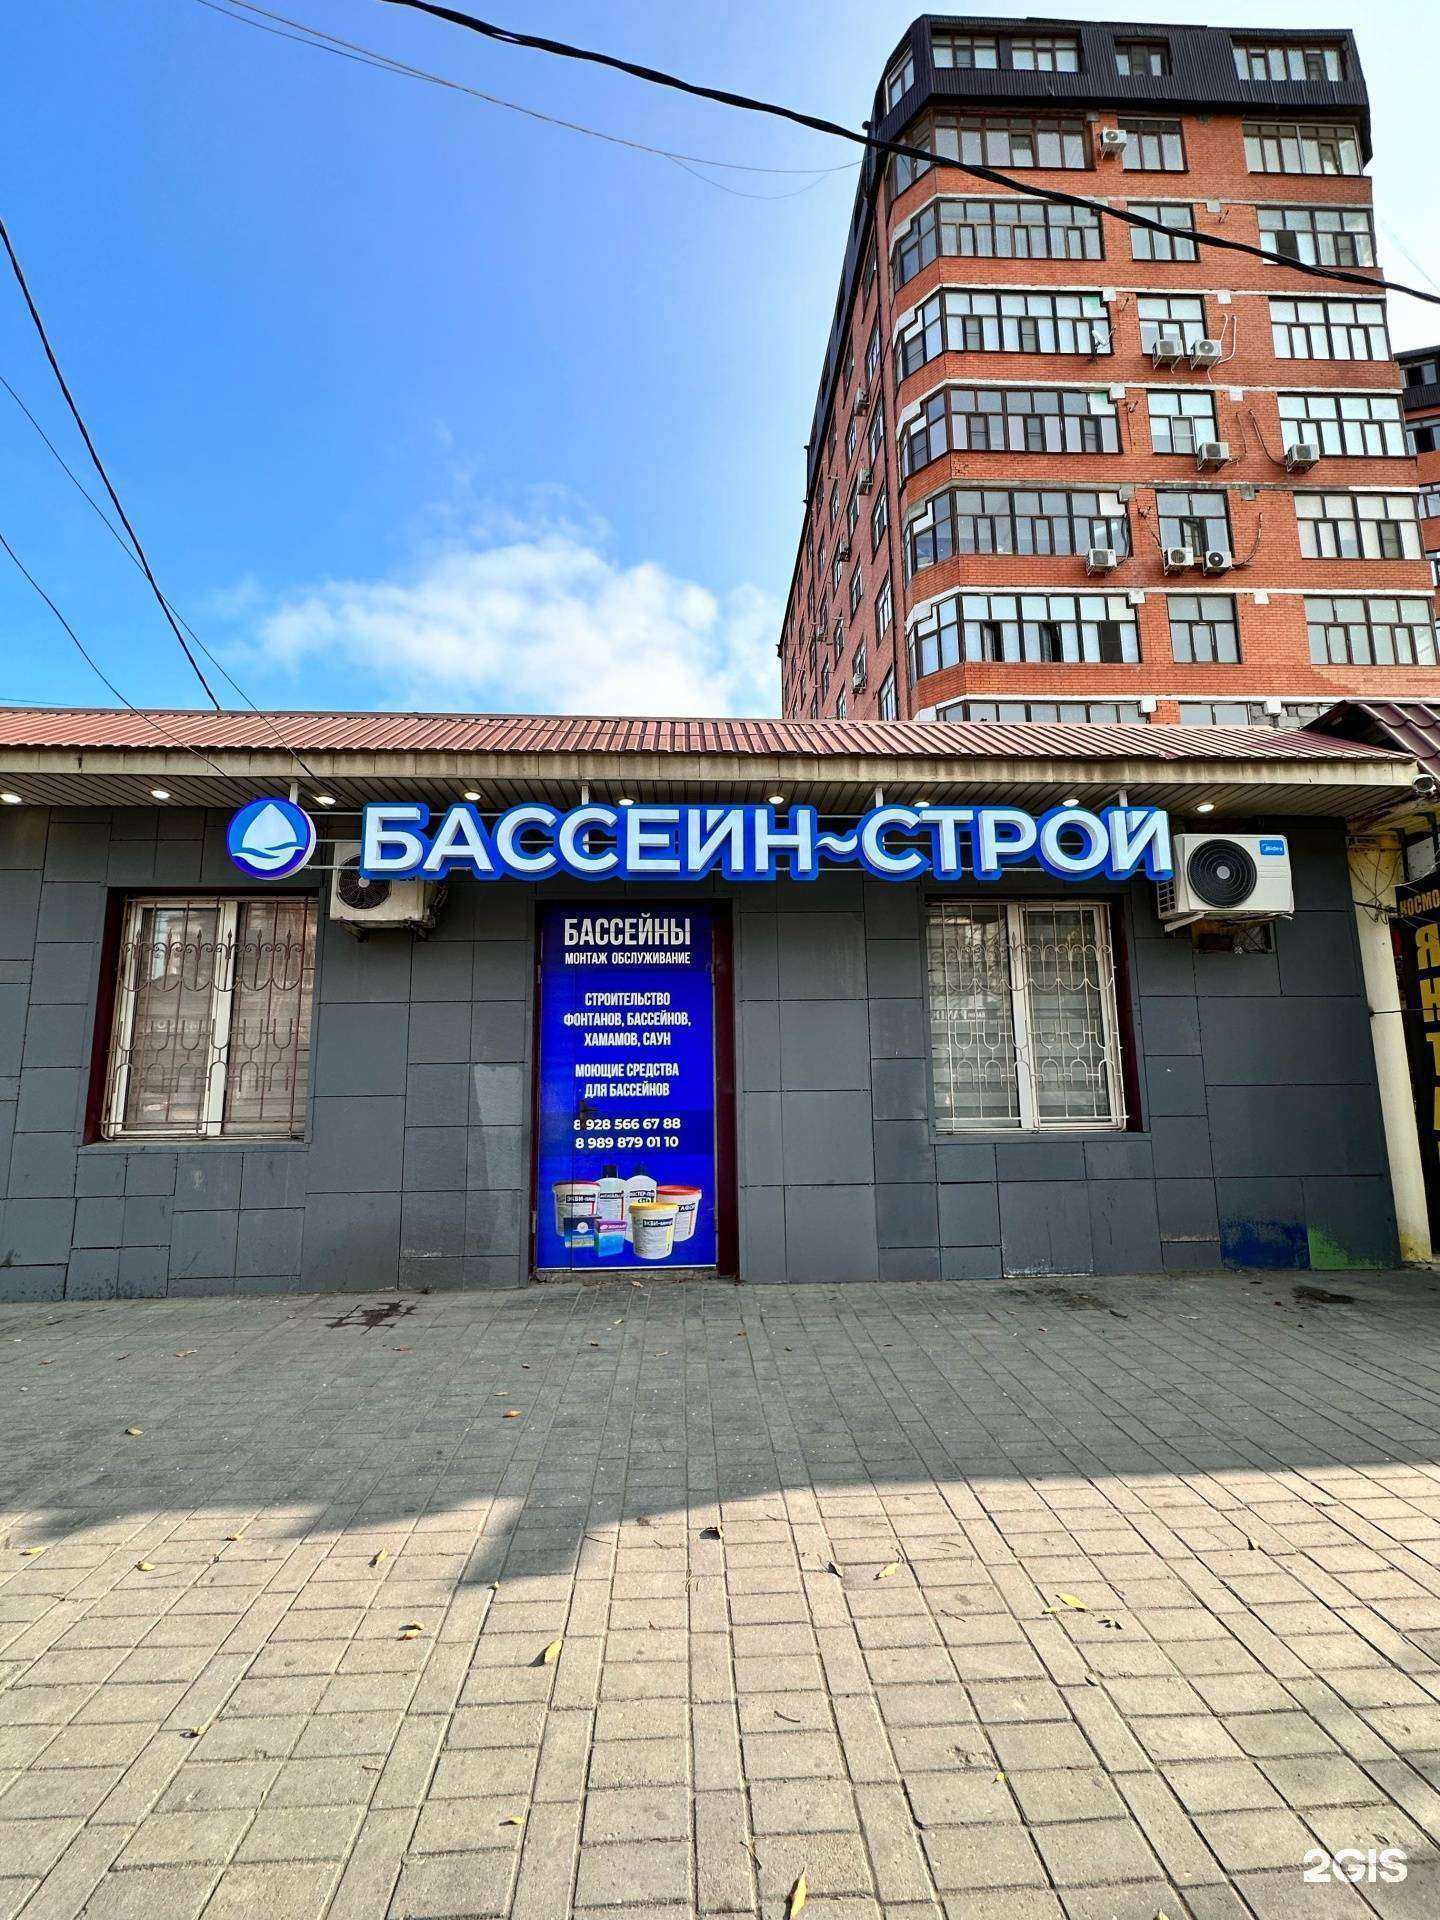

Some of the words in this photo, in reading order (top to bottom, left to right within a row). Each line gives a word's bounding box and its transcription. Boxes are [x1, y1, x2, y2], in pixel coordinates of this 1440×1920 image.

[565, 913, 691, 945] БАССЕЙНЫ
[565, 952, 608, 964] МОНТАЖ
[611, 952, 691, 964] ОБСЛУЖИВАНИЕ
[584, 992, 671, 1006] СТРОИТЕЛЬСТВО
[563, 1012, 625, 1027] ФОНТАНОВ,
[627, 1010, 692, 1027] БАССЕЙНОВ,
[584, 1032, 640, 1047] ХАМАМОВ,
[643, 1032, 671, 1047] САУН
[575, 1064, 625, 1078] МОЮЩИЕ
[626, 1063, 680, 1077] СРЕДСТВА
[584, 1083, 608, 1098] ДЛЯ
[609, 1081, 670, 1097] БАССЕЙНОВ
[573, 1119, 581, 1131] 8
[585, 1119, 611, 1130] 928
[614, 1119, 640, 1130] 566
[642, 1118, 660, 1130] 67
[662, 1117, 681, 1129] 88
[575, 1137, 584, 1149] 8
[587, 1137, 614, 1149] 989
[617, 1136, 643, 1148] 879
[646, 1136, 661, 1147] 01
[663, 1136, 679, 1147] 10
